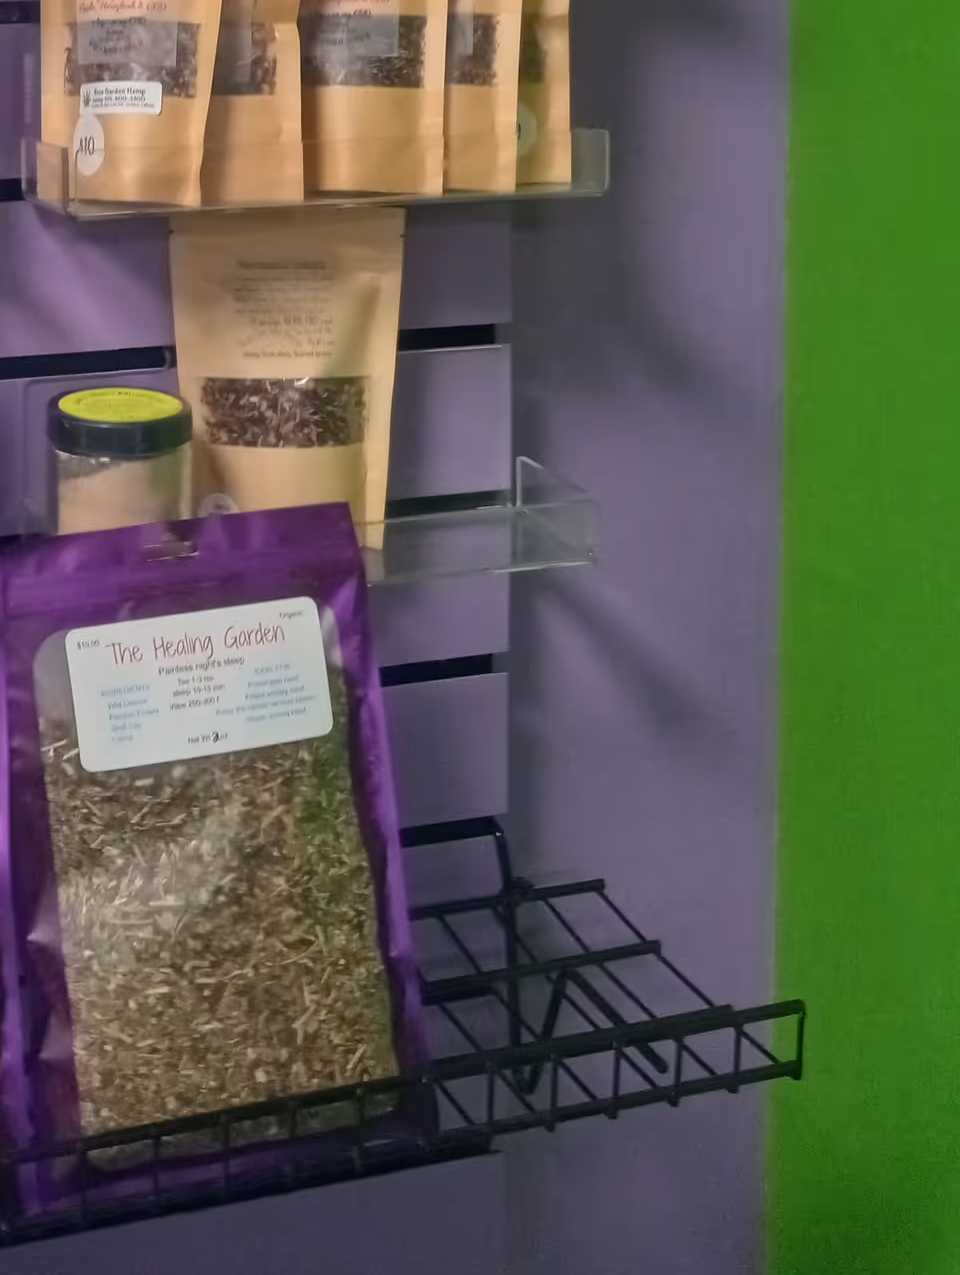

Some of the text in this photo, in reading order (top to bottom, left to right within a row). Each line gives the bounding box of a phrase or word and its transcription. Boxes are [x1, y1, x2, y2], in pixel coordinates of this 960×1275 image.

[127, 86, 146, 98] Hemp
[80, 135, 95, 156] $10
[105, 622, 285, 665] The Healing Garden
[158, 657, 245, 676] Painless night's sleep
